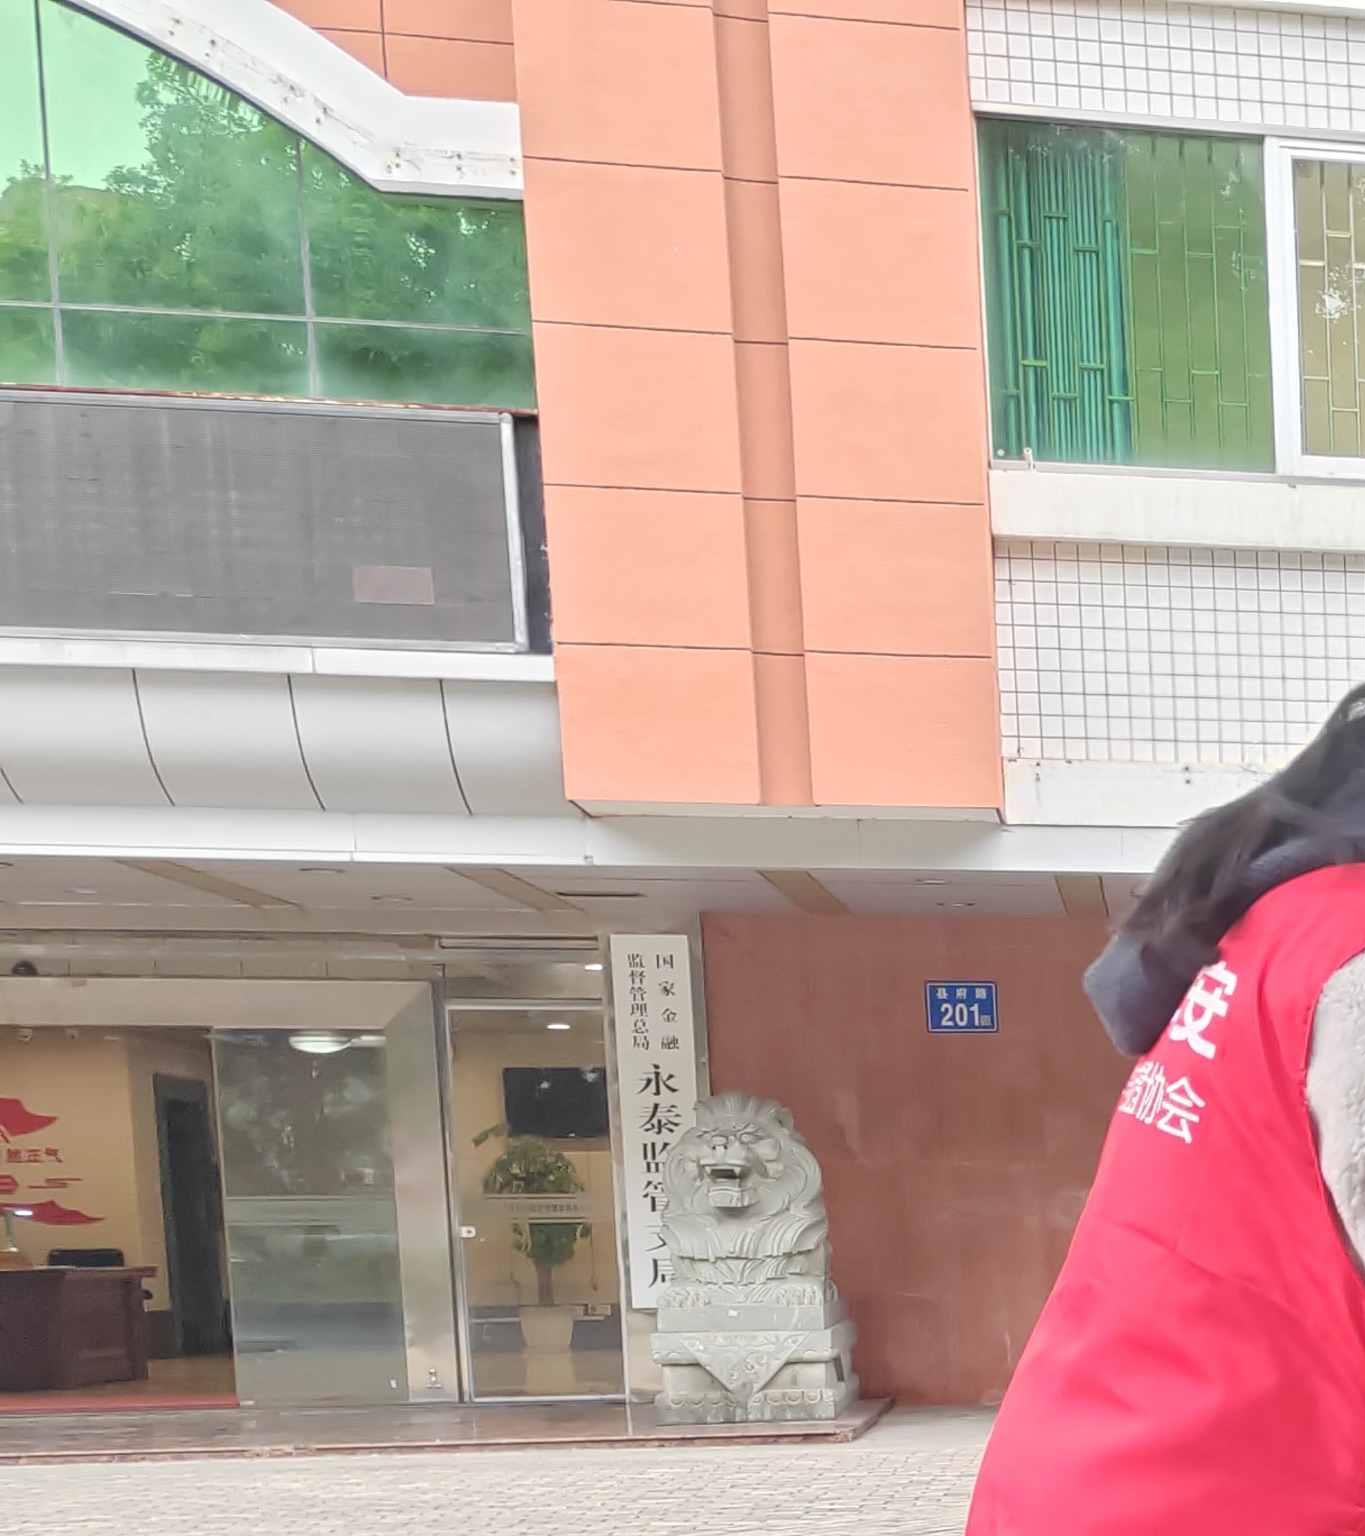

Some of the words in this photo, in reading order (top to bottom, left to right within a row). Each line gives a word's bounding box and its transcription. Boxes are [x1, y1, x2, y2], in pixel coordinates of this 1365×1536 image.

[627, 953, 650, 1051] 监督管理总局
[656, 953, 679, 1050] 国家金融
[940, 1003, 980, 1027] 201
